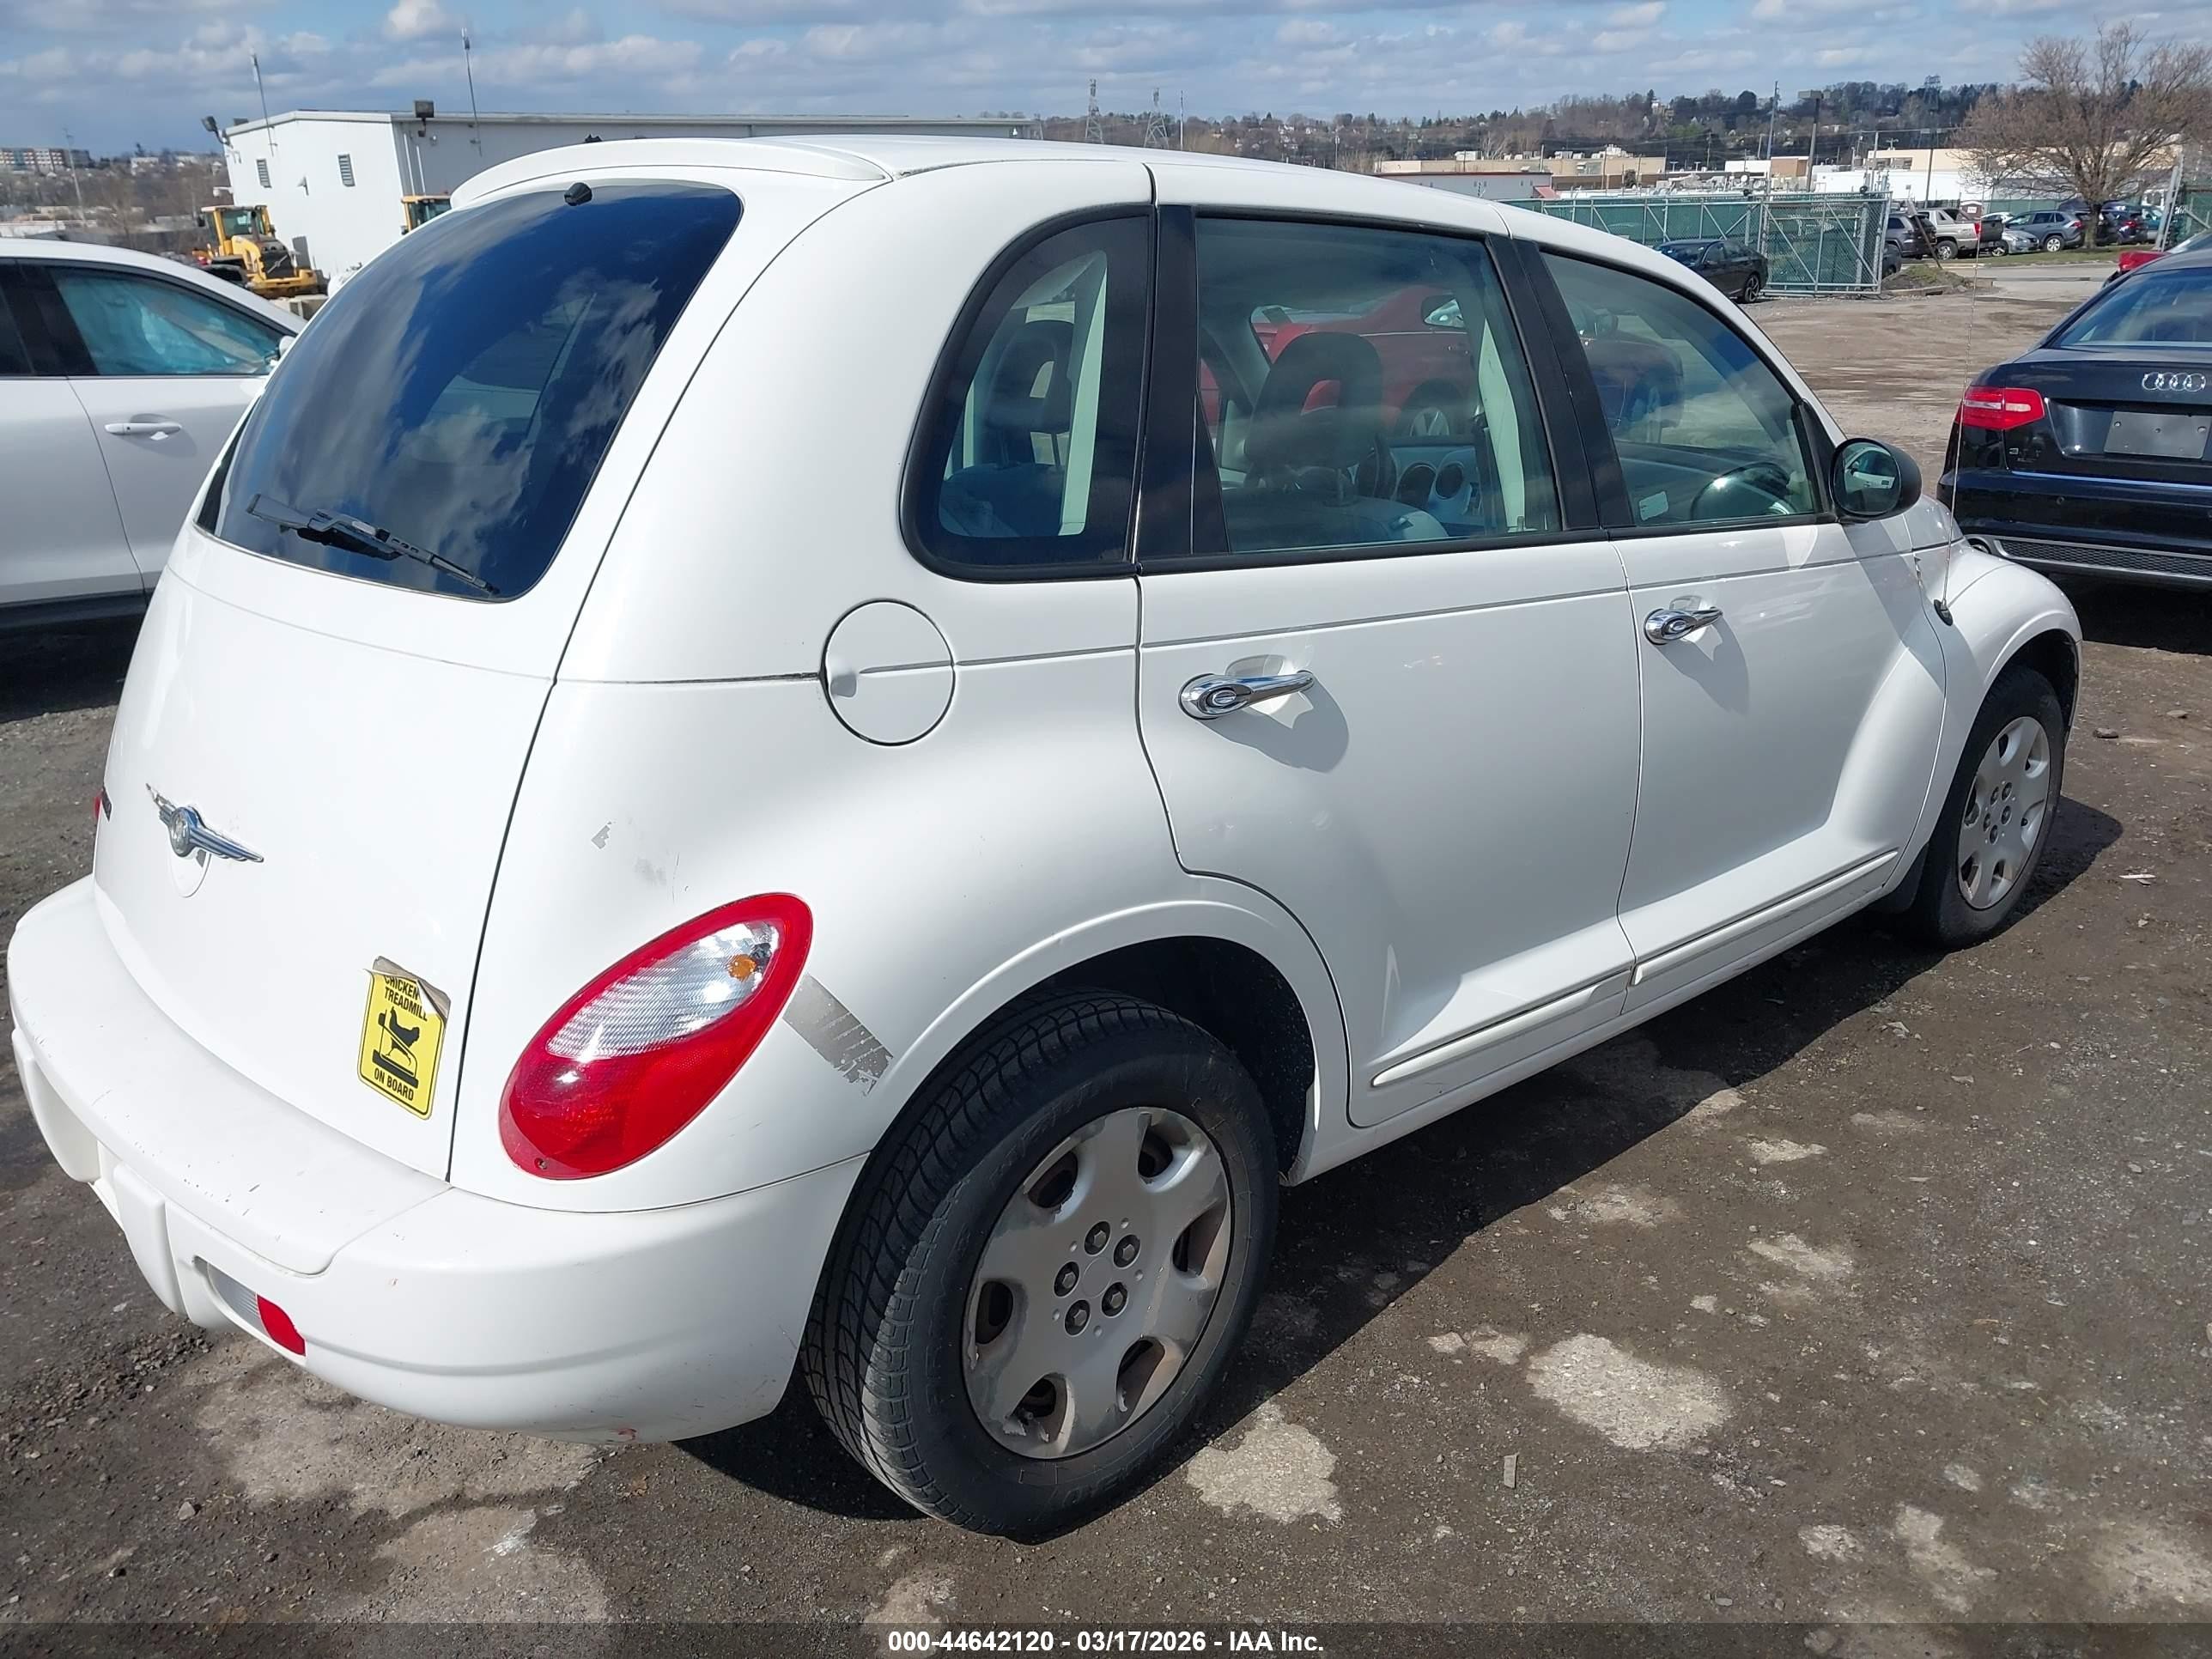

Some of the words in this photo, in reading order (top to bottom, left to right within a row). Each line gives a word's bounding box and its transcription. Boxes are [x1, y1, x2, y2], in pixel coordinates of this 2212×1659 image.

[384, 975, 420, 1000] CHICKEN
[385, 987, 428, 1022] TREADMILL
[374, 1067, 386, 1085] ON
[386, 1074, 414, 1102] BOARD
